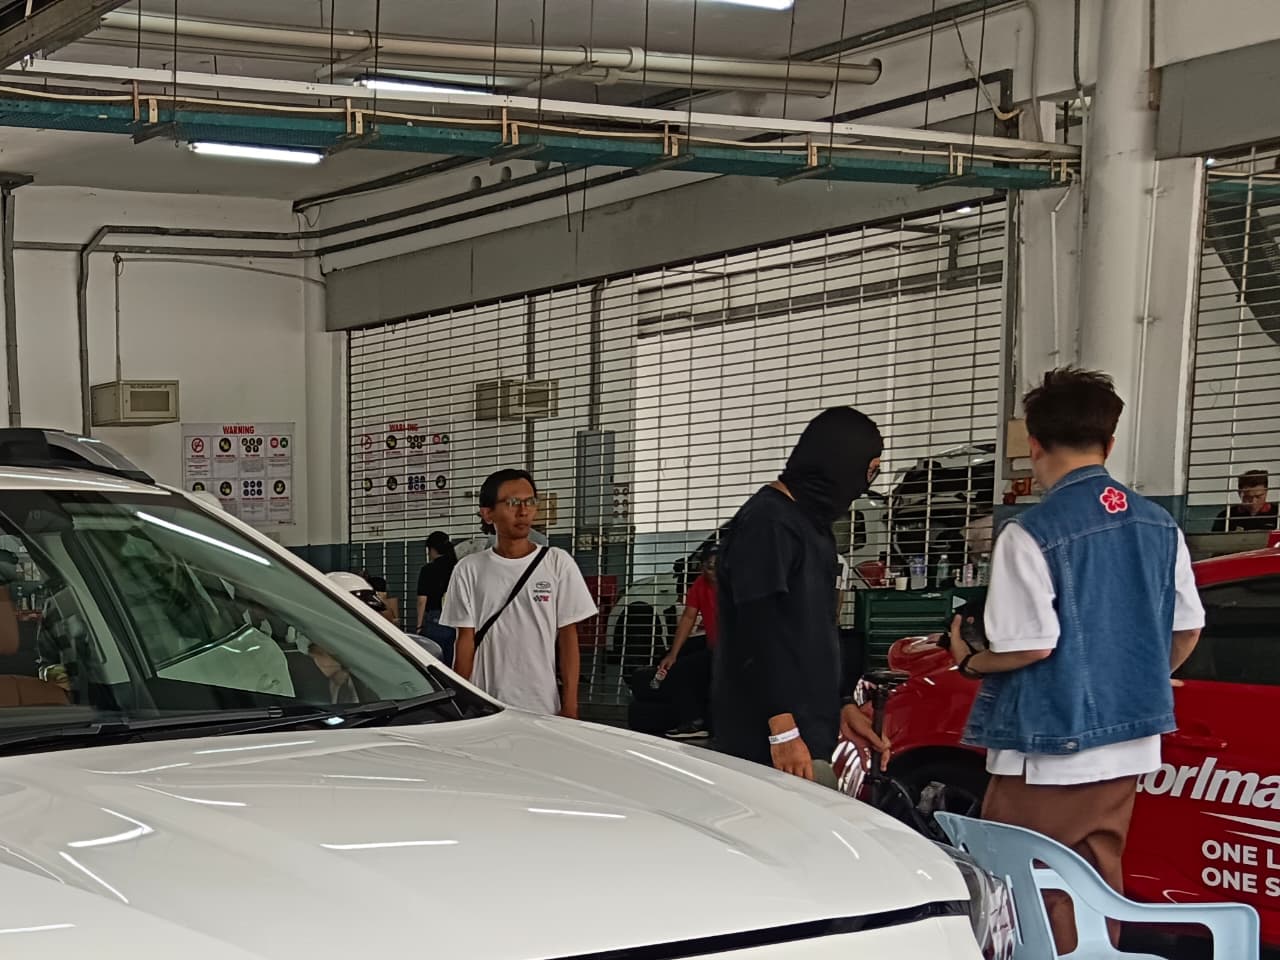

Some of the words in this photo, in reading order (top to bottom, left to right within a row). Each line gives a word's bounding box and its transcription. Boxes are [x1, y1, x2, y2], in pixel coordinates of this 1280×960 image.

[223, 425, 255, 434] WARNING
[1136, 756, 1280, 809] orlma
[1201, 839, 1258, 866] ONE
[1201, 867, 1258, 894] ONE
